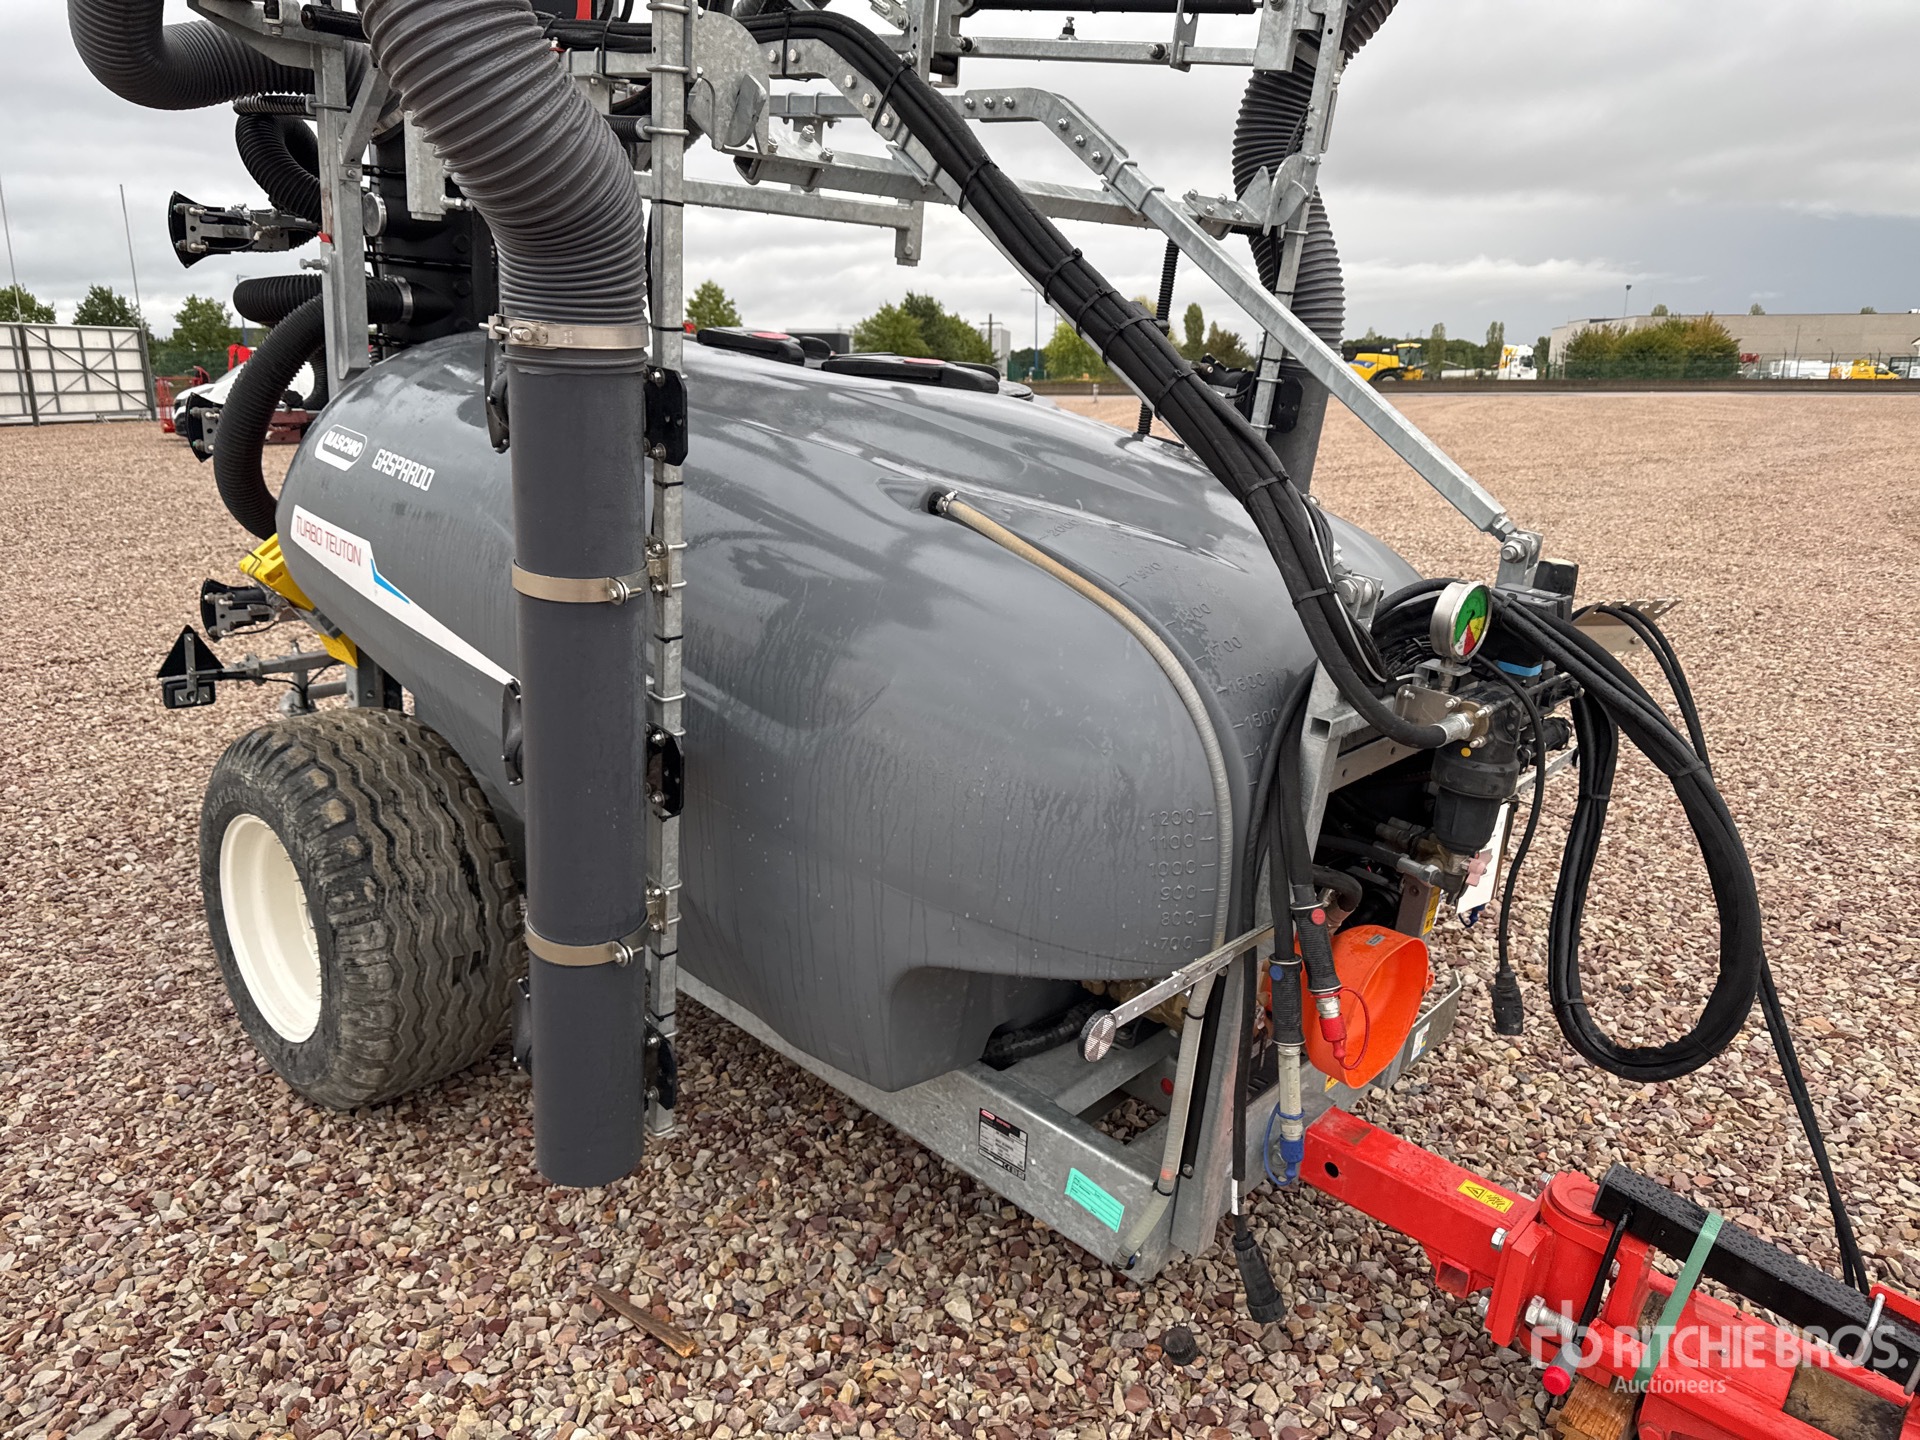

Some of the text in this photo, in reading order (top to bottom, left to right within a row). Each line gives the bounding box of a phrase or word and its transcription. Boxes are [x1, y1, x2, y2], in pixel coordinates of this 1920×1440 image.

[324, 430, 363, 458] MASCHIO
[371, 448, 436, 491] GASPARDO
[296, 514, 362, 567] TURBO TEUTON
[1149, 808, 1196, 826] 1200
[1149, 833, 1196, 851] 1100
[1148, 859, 1197, 877] 1000
[1160, 884, 1197, 901] 900
[1160, 910, 1195, 926] 800
[1159, 935, 1193, 950] 700
